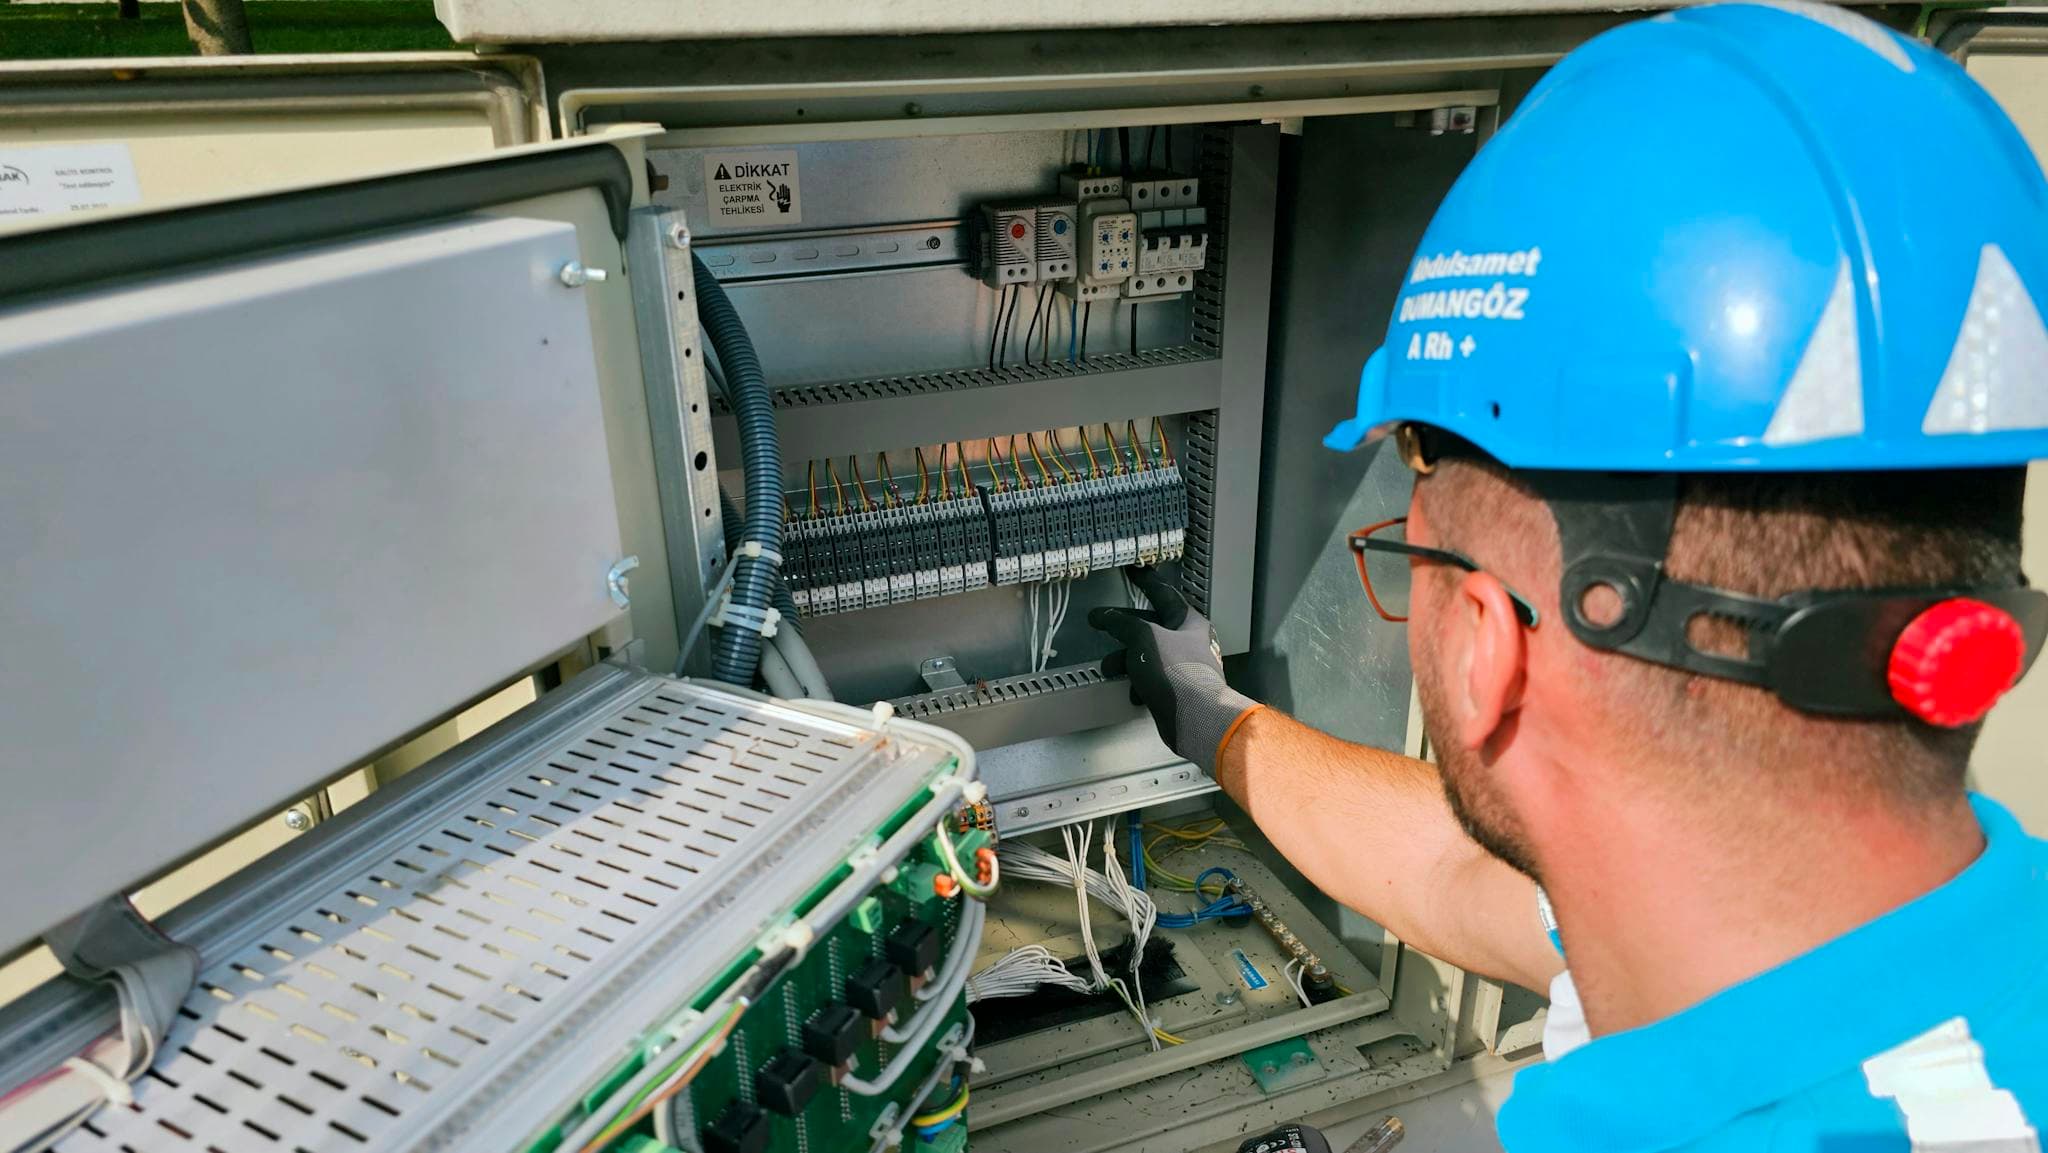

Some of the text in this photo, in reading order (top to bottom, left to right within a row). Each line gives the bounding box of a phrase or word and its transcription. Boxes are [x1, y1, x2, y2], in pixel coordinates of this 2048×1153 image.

[735, 162, 790, 178] DİKKAT
[719, 181, 762, 193] ELEKTRİK
[723, 194, 760, 205] ÇARPMA
[720, 203, 765, 216] TEHLİKESİ
[1406, 331, 1421, 360] A
[1423, 330, 1454, 360] Rh
